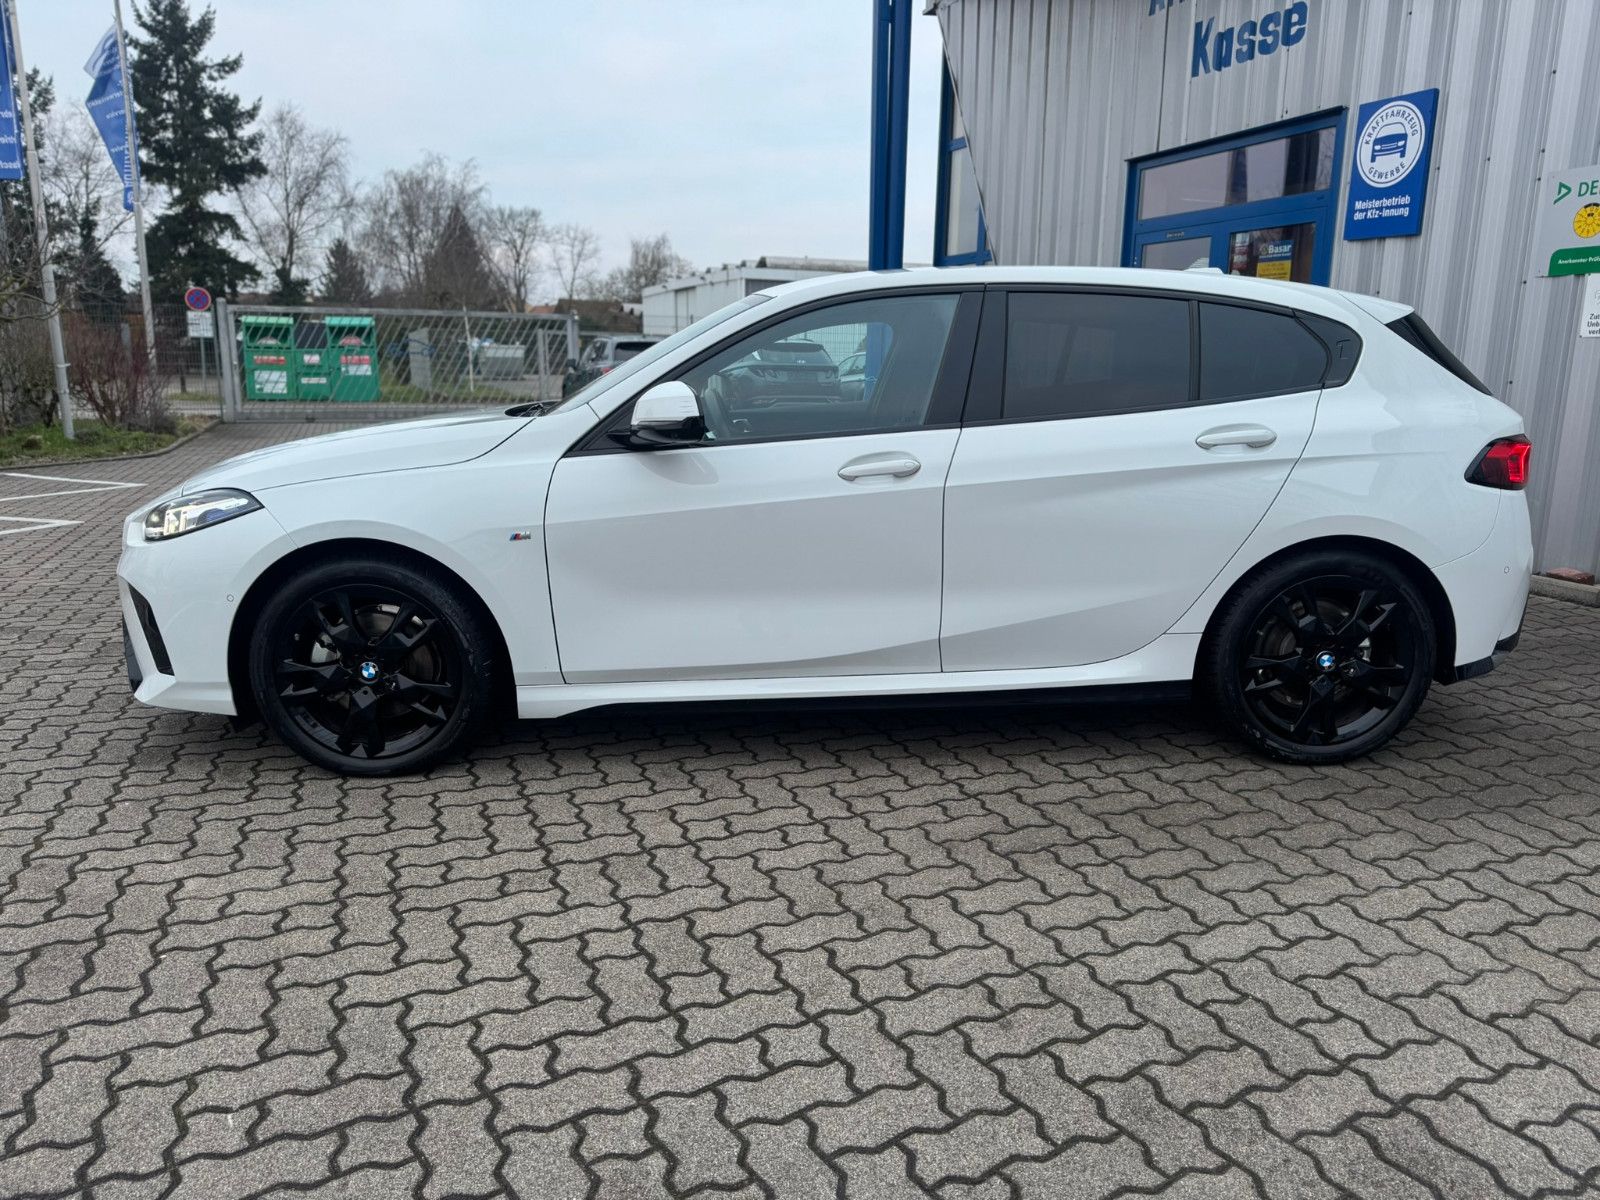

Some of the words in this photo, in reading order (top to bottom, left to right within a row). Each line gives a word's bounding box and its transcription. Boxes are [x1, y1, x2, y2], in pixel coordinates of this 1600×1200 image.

[1191, 1, 1308, 78] Kasse
[1365, 110, 1418, 144] KRAFTFAHRZEUG
[1368, 161, 1407, 180] GEWERBE
[1577, 179, 1600, 197] DE
[1354, 195, 1411, 210] Meisterbetrieb
[1353, 210, 1366, 220] der
[1366, 207, 1410, 219] Kfz-Innung
[1268, 244, 1292, 254] Basar
